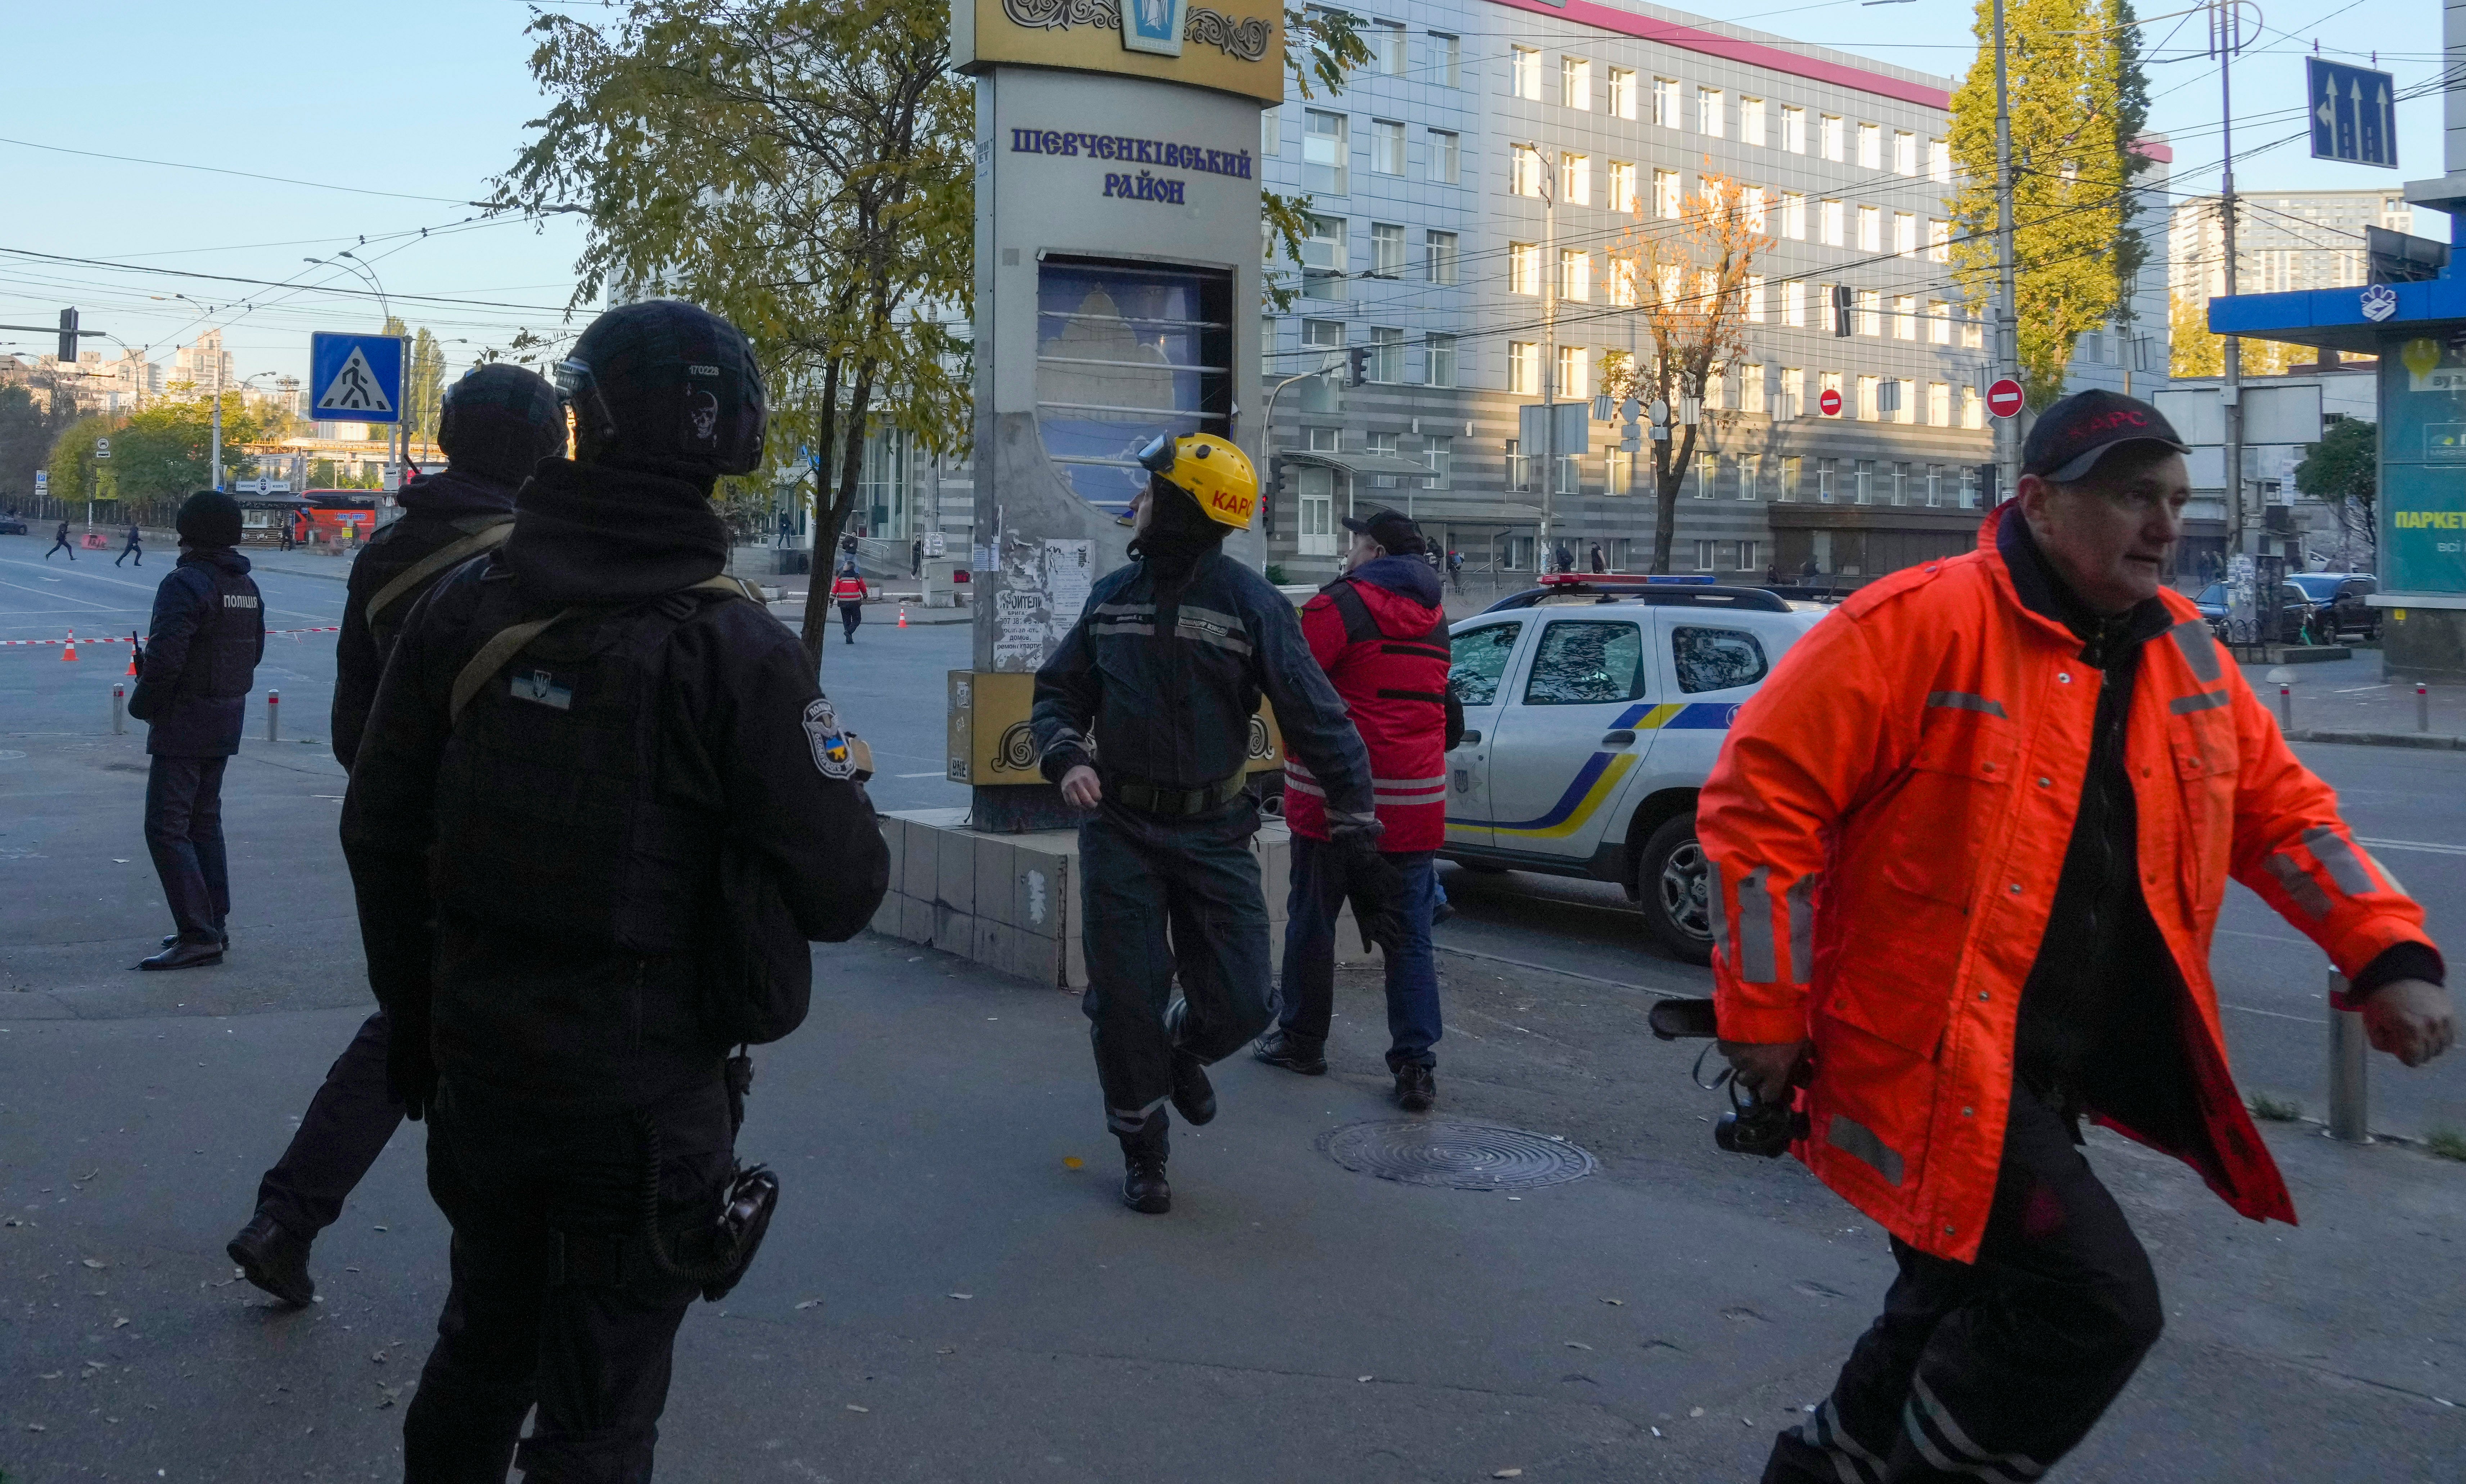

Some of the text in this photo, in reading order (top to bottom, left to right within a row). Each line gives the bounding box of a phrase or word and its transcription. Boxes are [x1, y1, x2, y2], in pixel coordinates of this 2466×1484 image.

[1102, 169, 1185, 205] РАЙОН
[689, 365, 719, 376] 170228
[224, 595, 258, 608] ПОЛІЦІЯ
